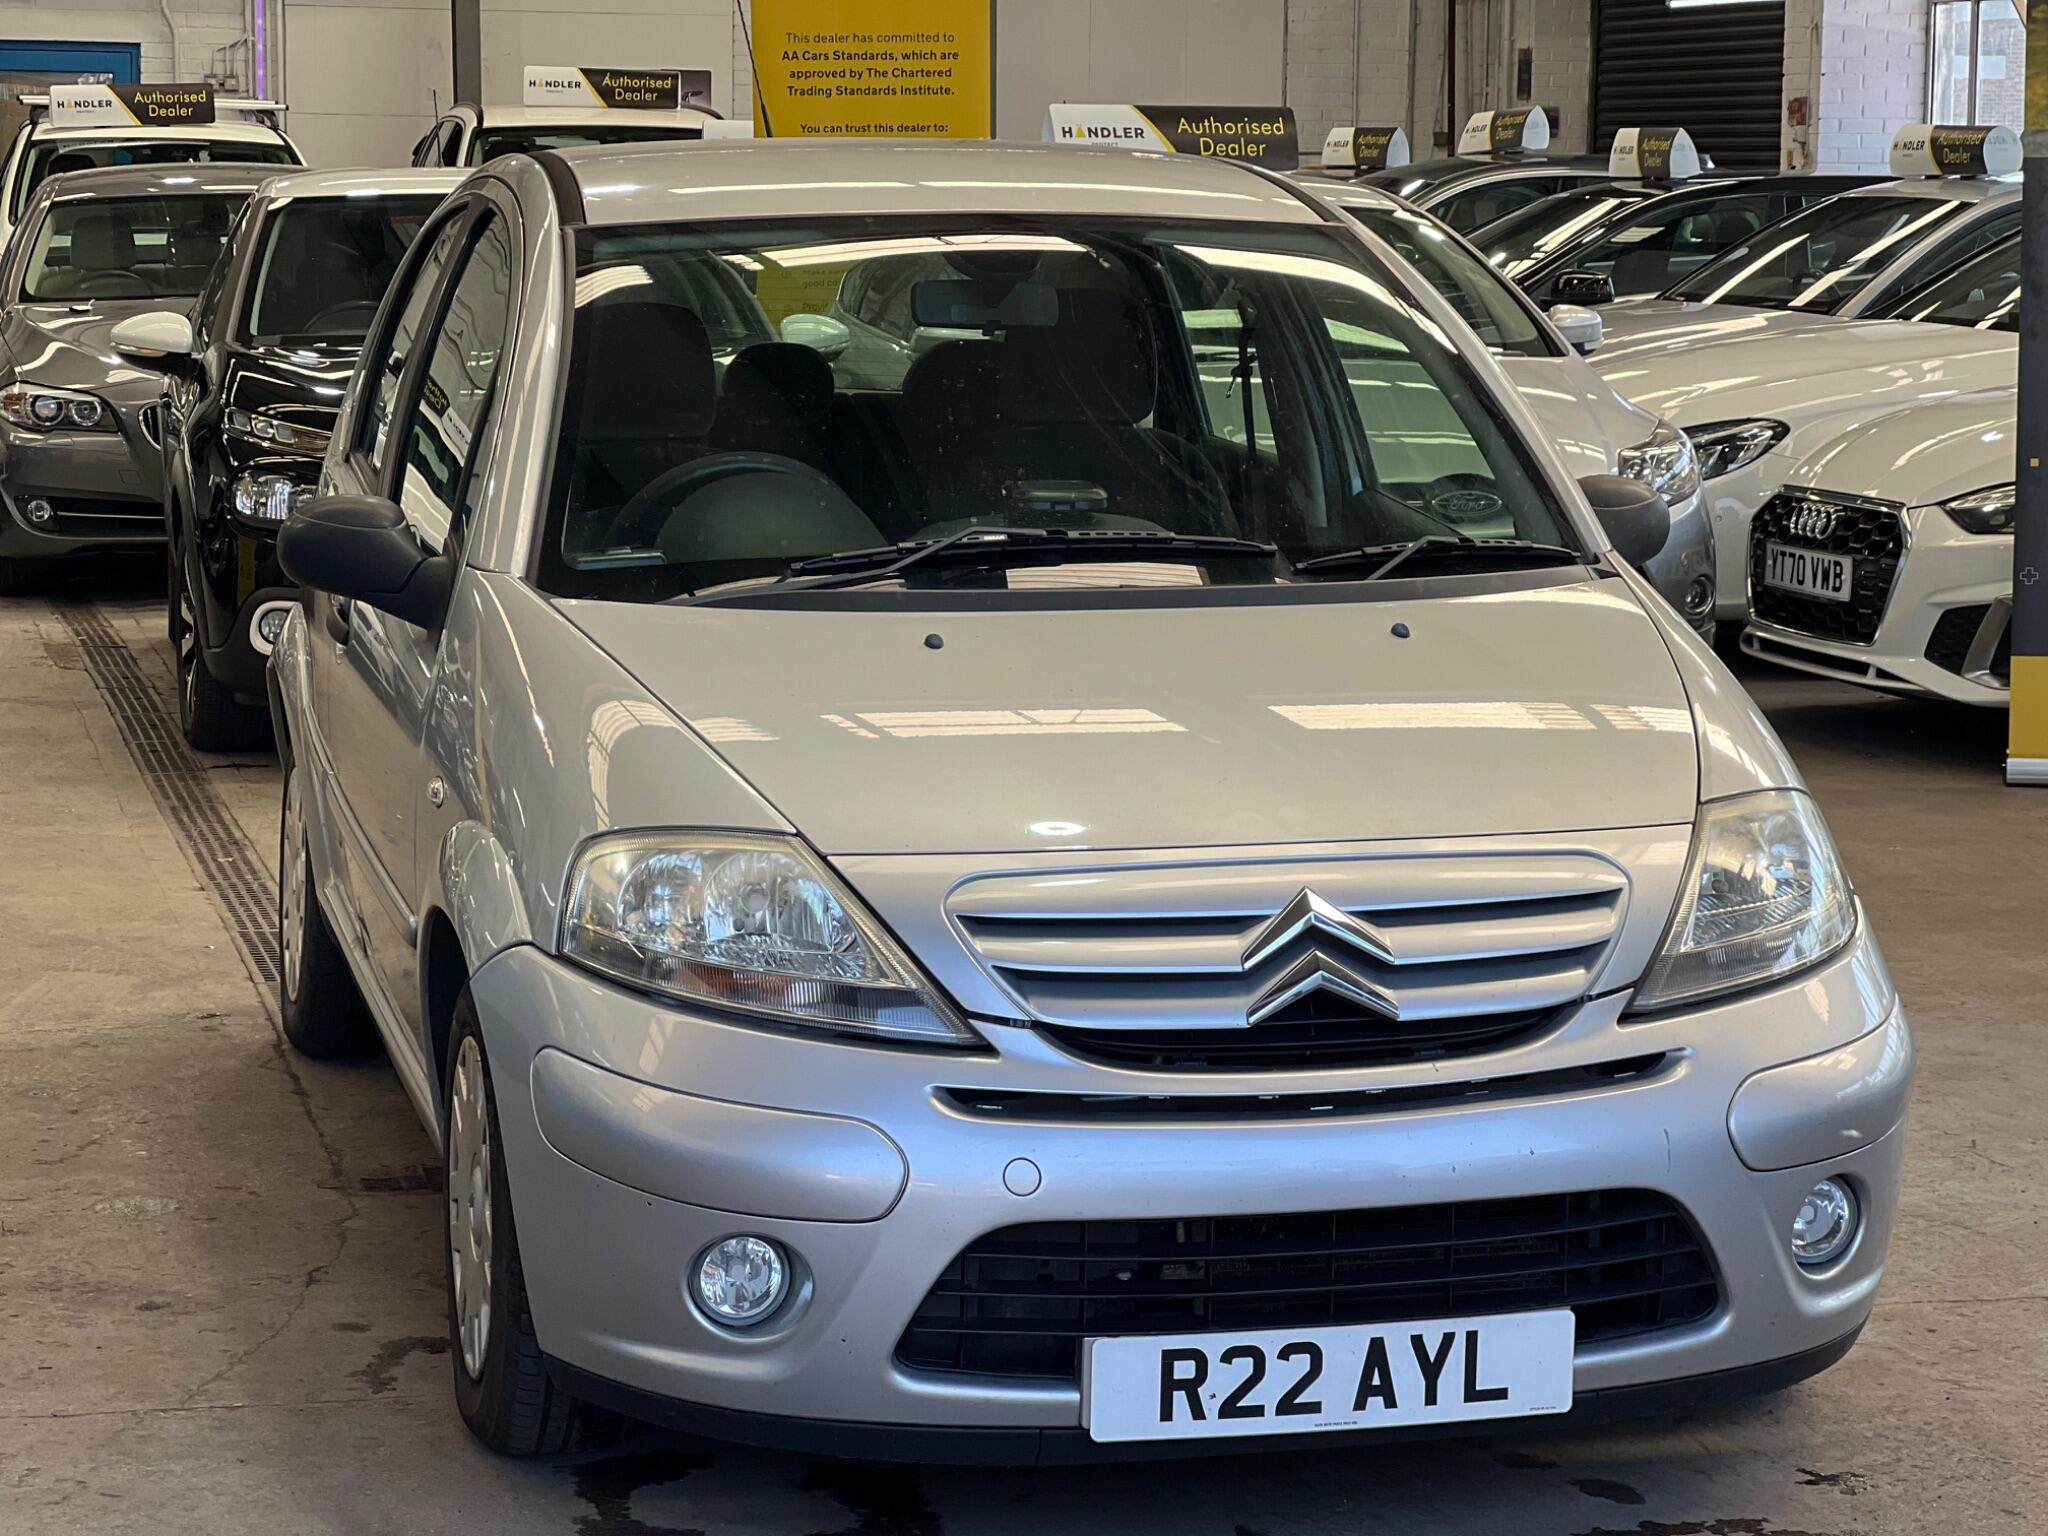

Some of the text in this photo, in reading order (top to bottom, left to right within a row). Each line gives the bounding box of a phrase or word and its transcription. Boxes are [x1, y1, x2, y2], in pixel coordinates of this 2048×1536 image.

[786, 32, 955, 43] This dealer has committed to
[782, 50, 959, 62] AA Cars Standards, which are
[789, 67, 952, 80] approved by The Chartered
[602, 73, 672, 88] Authorised
[134, 90, 206, 104] Authorised
[615, 89, 658, 101] Dealer
[787, 85, 955, 98] Trading Standards Institute.
[149, 105, 193, 117] Dealer
[800, 123, 949, 134] You can trust this dealer to:
[1177, 116, 1285, 135] Authorised
[1061, 126, 1145, 139] HANDLER
[1937, 130, 1986, 145] Authorised
[1200, 138, 1266, 156] Dealer
[1943, 147, 1971, 163] Dealer
[1771, 548, 1844, 593] YT70 VWB
[1159, 1329, 1509, 1423] R22 AYL
